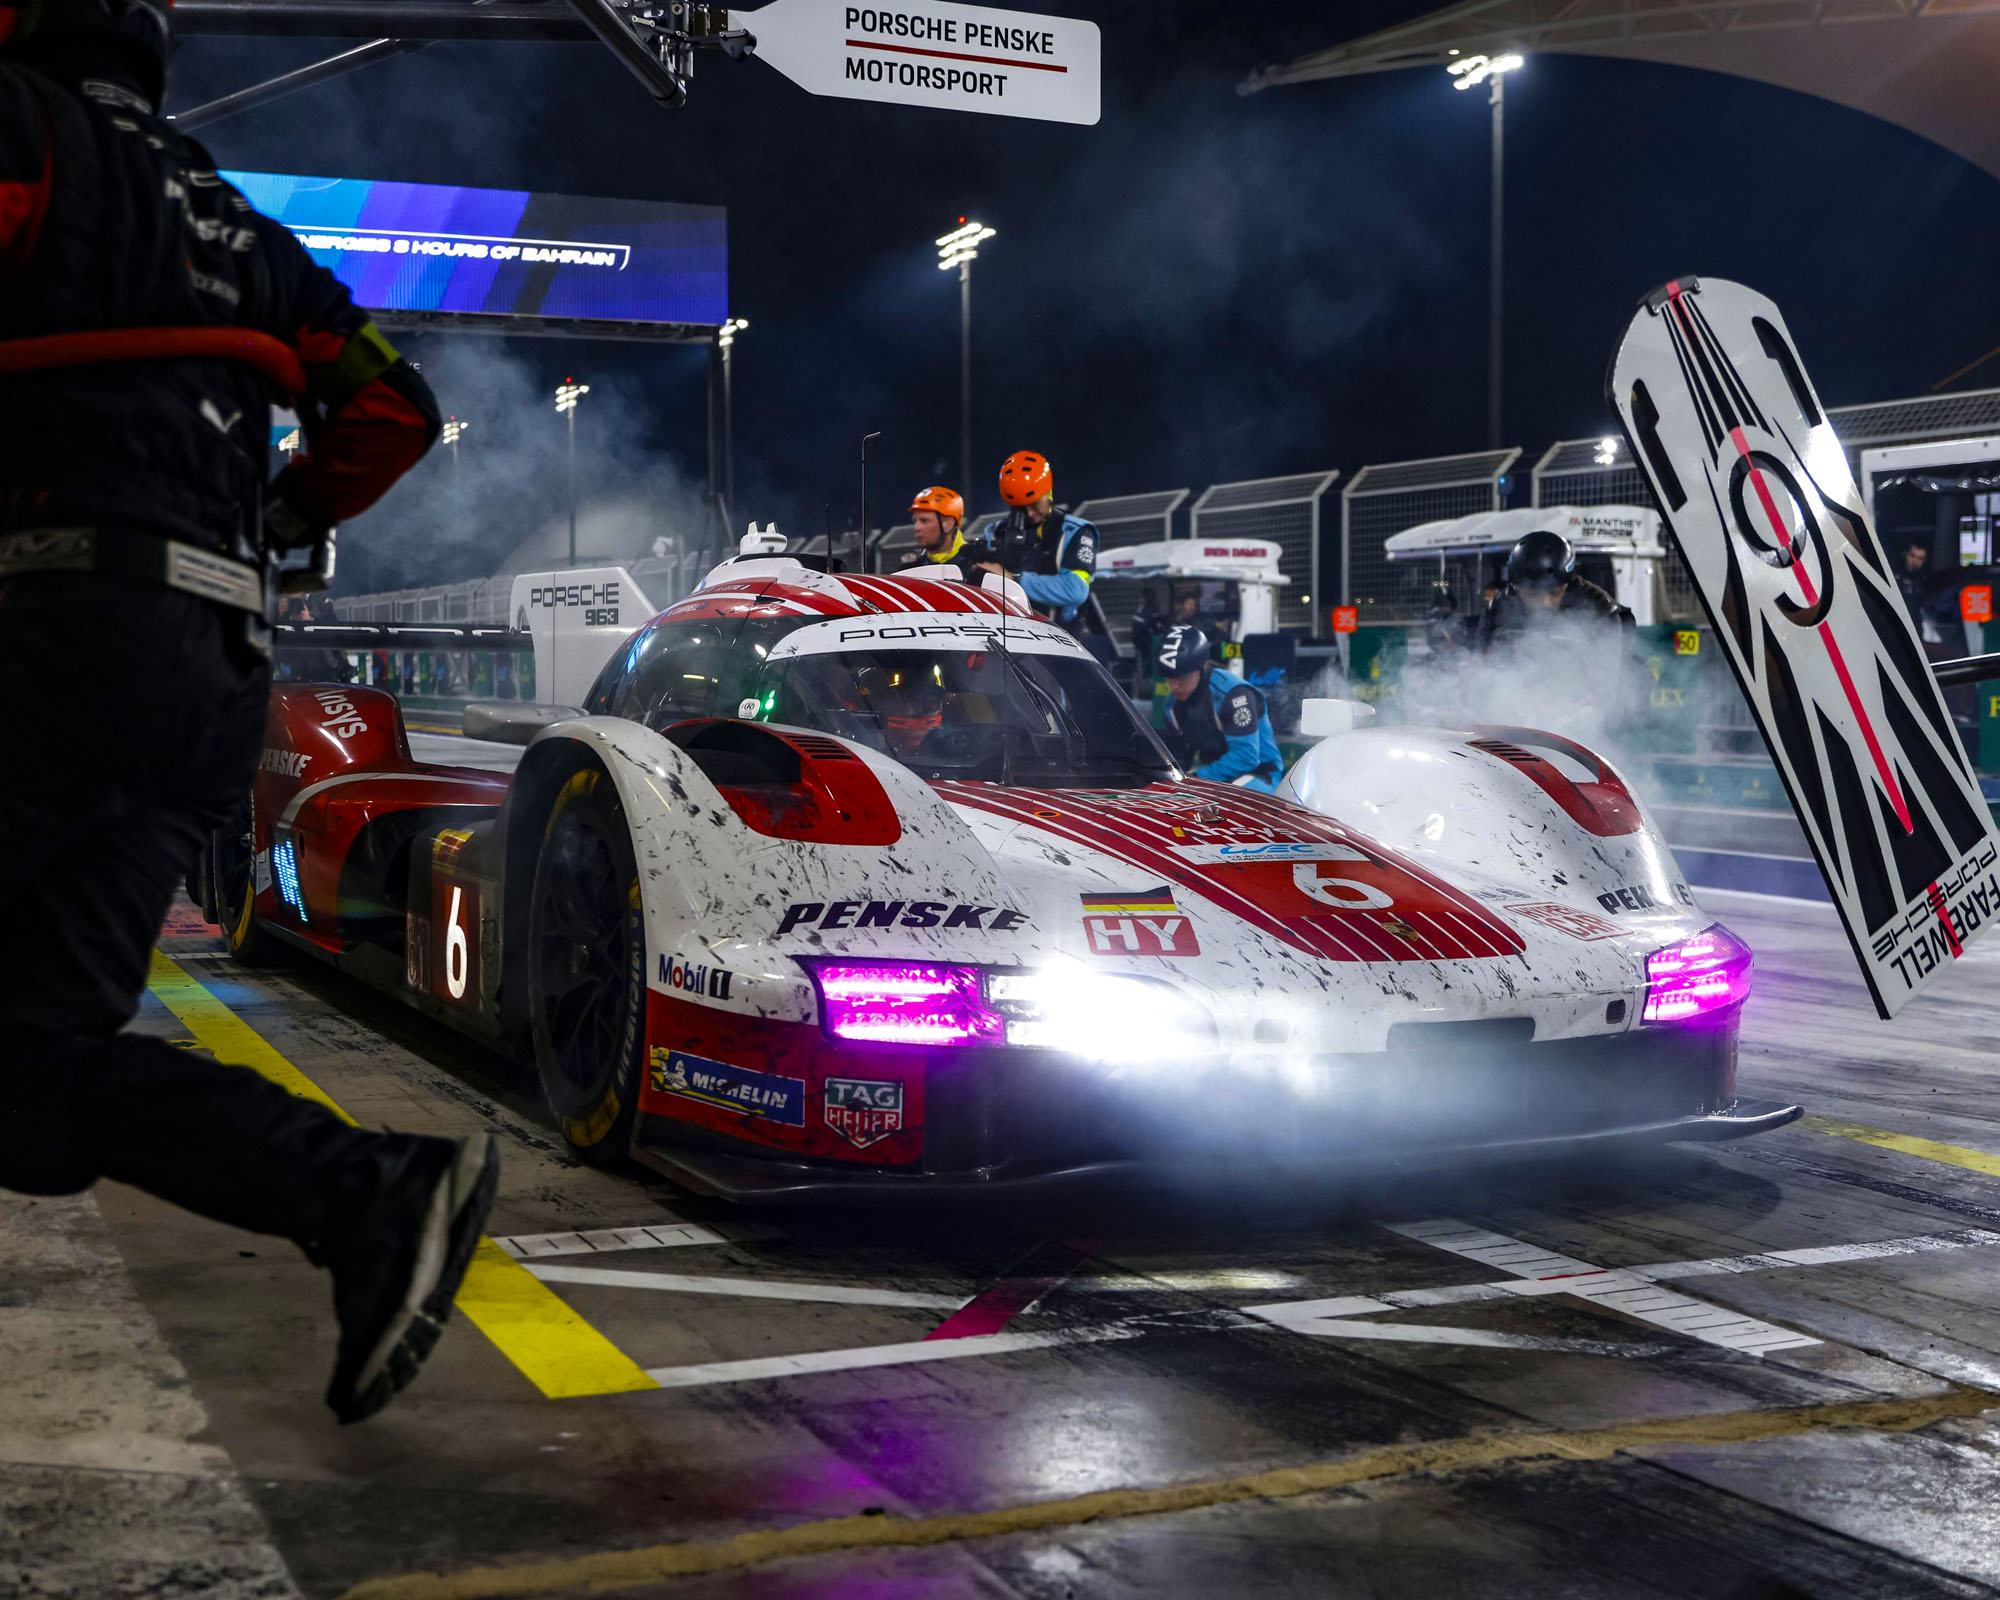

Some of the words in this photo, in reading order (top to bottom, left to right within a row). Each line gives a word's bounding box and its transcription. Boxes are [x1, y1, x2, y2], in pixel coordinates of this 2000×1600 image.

[845, 7, 957, 43] PORSCHE
[965, 22, 1054, 55] PENSKE
[845, 57, 1008, 97] MOTORSPORT
[295, 234, 391, 253] NERGIES
[411, 240, 489, 259] HOURS
[490, 245, 520, 261] OF
[522, 248, 616, 267] BAHRAIN
[1583, 517, 1643, 528] MANTHEY
[1204, 547, 1229, 557] IRON
[1232, 547, 1267, 558] DAMES
[531, 582, 619, 608] PORSCHE
[585, 608, 619, 626] 963
[839, 625, 1080, 648] PORSCHE
[1220, 844, 1315, 854] WEC
[1292, 863, 1395, 910] 6
[1872, 840, 1998, 962] PORSCHE
[776, 901, 1031, 934] PENSKE
[1890, 873, 2000, 990] FAREWELL
[446, 886, 468, 999] 6
[1089, 919, 1183, 951] HY
[658, 953, 707, 996] Mobil
[831, 1083, 895, 1107] TAG
[829, 1109, 897, 1142] HEUER
